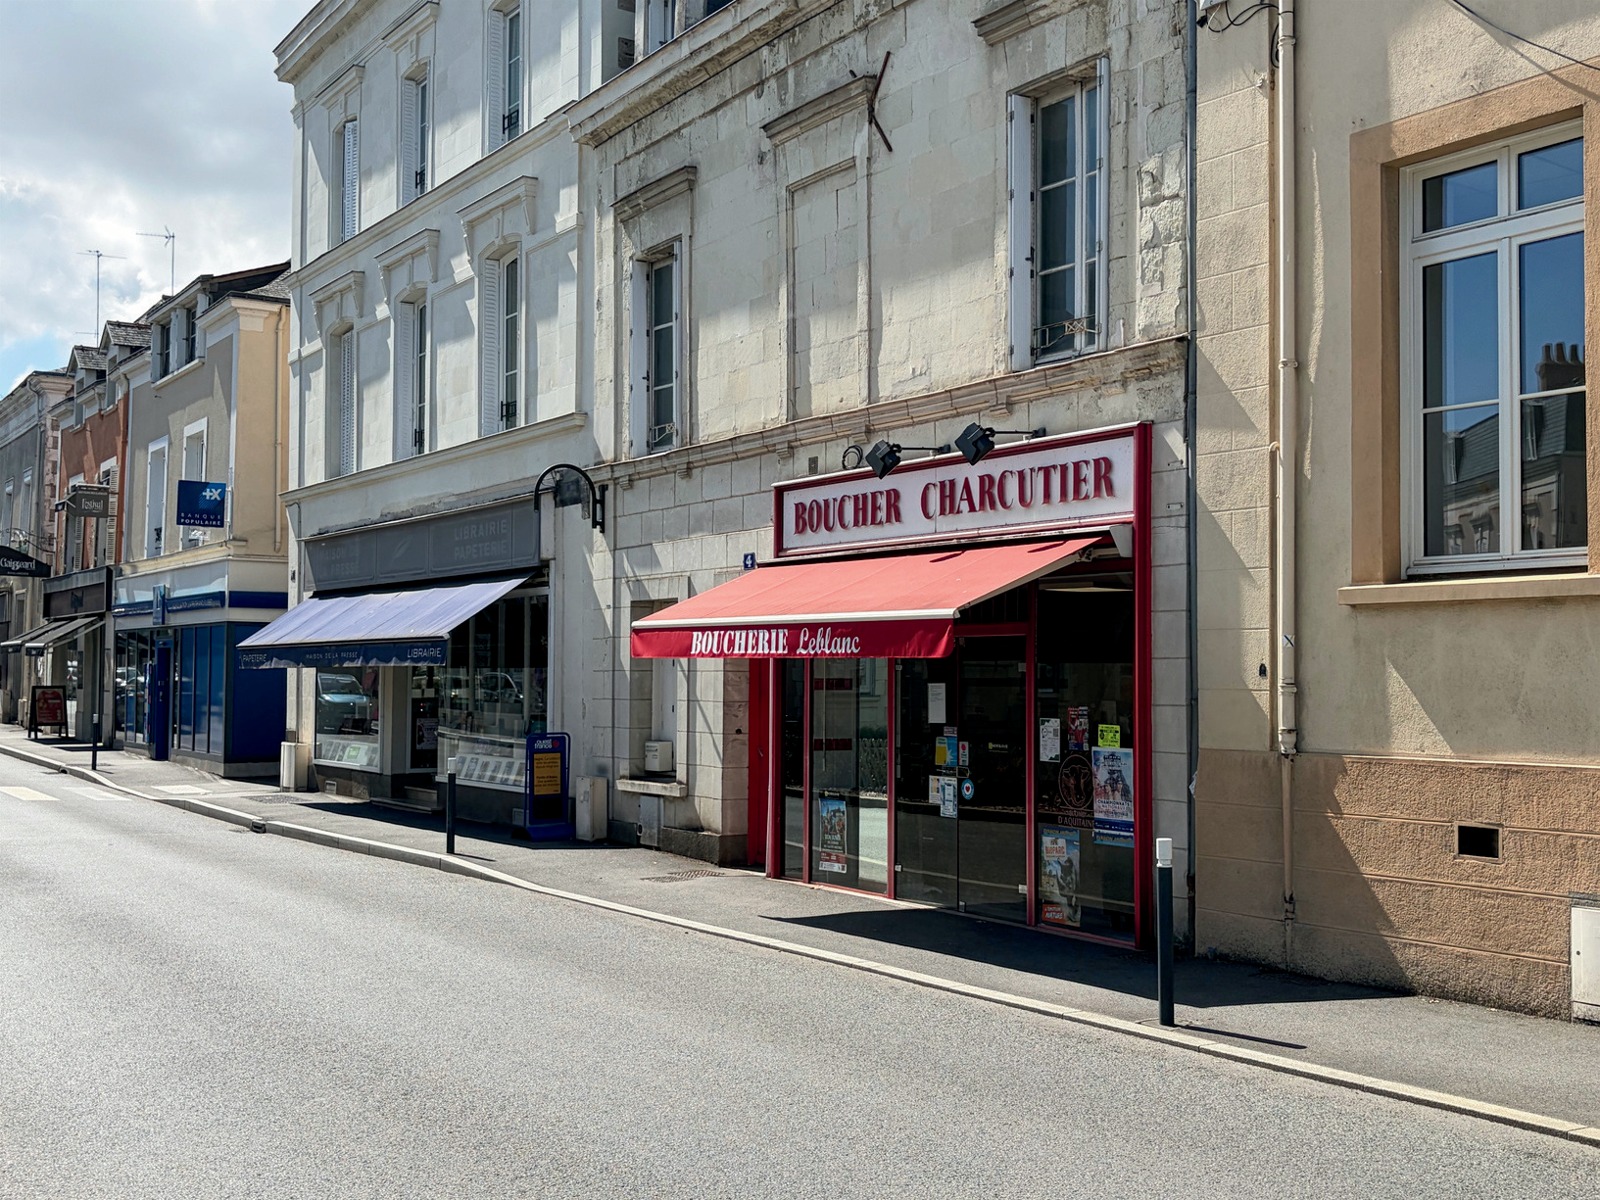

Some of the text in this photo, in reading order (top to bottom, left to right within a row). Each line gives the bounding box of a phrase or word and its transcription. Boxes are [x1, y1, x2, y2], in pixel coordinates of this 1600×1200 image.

[793, 456, 1115, 535] BOUCHER CHARCUTIER
[180, 518, 221, 526] POPULAIRE
[454, 519, 507, 540] LIBRAIRIE
[454, 540, 507, 561] PAPETERIE
[745, 554, 753, 568] 4
[690, 626, 861, 655] BOUCHERIE Leblanc
[242, 653, 268, 662] PAPETERIE
[407, 647, 442, 658] LIBRAIRIE
